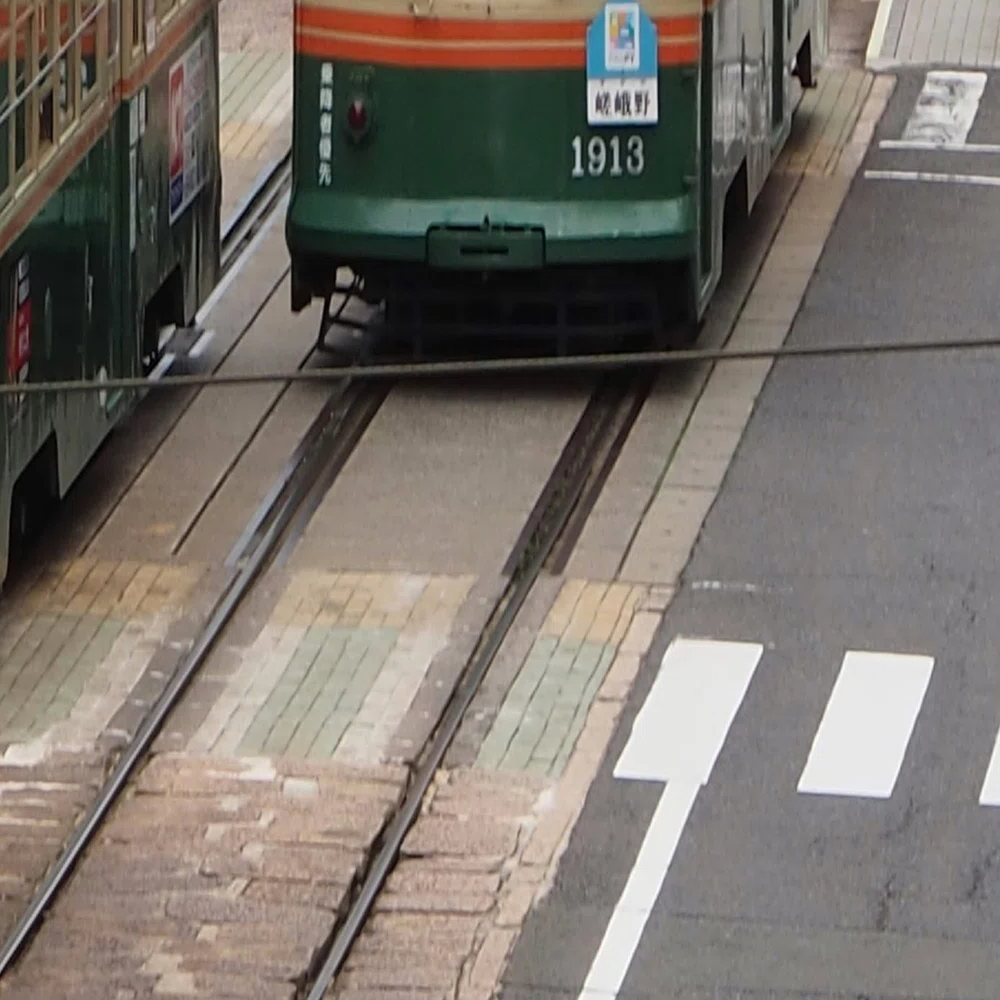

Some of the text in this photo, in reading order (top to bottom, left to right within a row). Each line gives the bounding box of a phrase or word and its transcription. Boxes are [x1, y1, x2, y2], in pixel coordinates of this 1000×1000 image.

[594, 90, 651, 118] 嵯峨野
[571, 135, 645, 178] 1913
